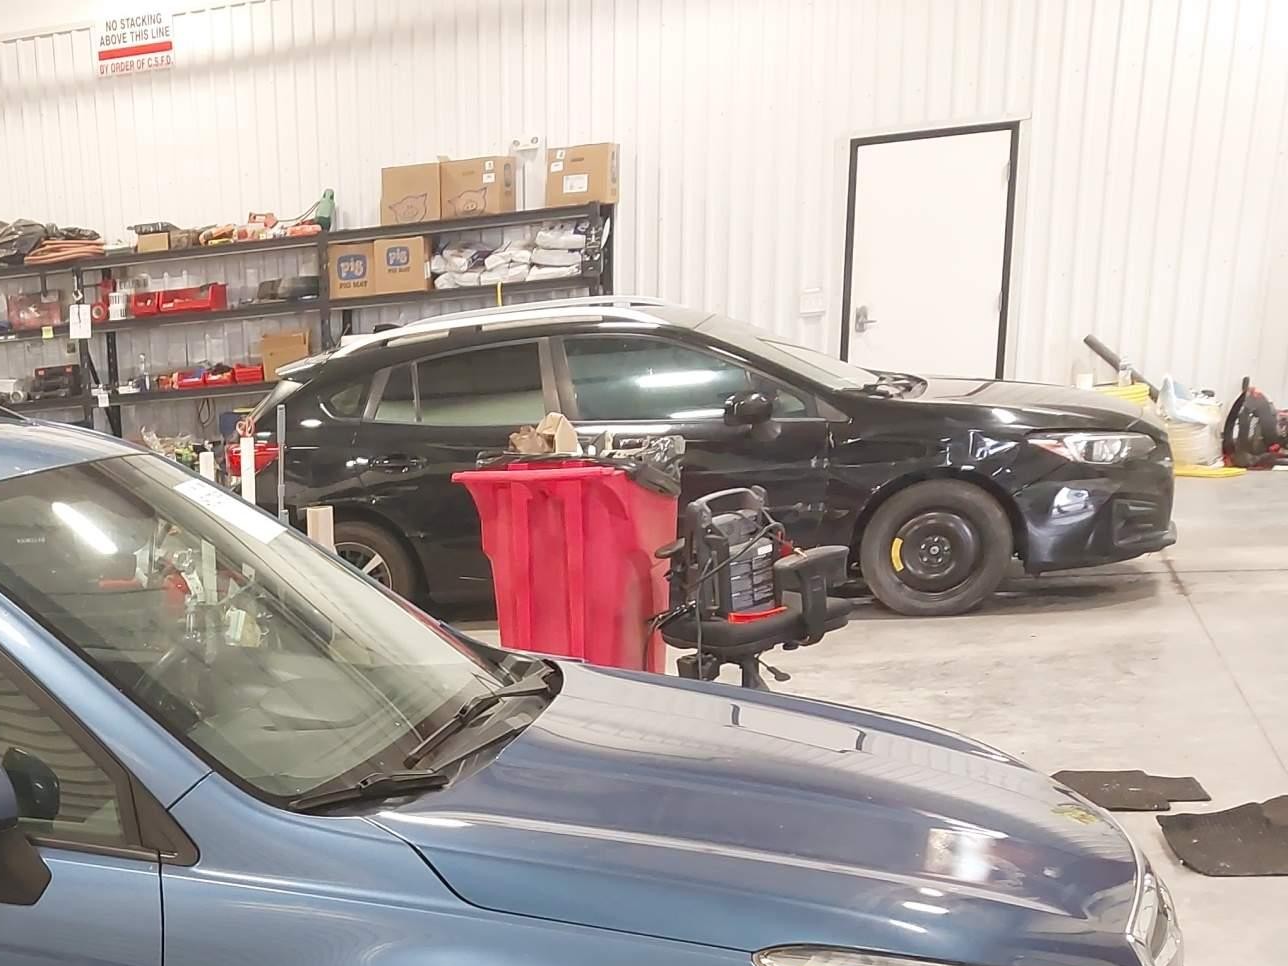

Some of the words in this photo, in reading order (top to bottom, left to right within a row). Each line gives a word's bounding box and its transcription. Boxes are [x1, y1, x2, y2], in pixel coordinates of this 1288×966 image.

[105, 19, 118, 32] NO
[120, 13, 162, 30] STACKING
[99, 32, 128, 47] ABOVE
[130, 28, 149, 43] THIS
[151, 26, 170, 39] LINE
[110, 60, 135, 73] ORDER
[136, 58, 146, 70] OF
